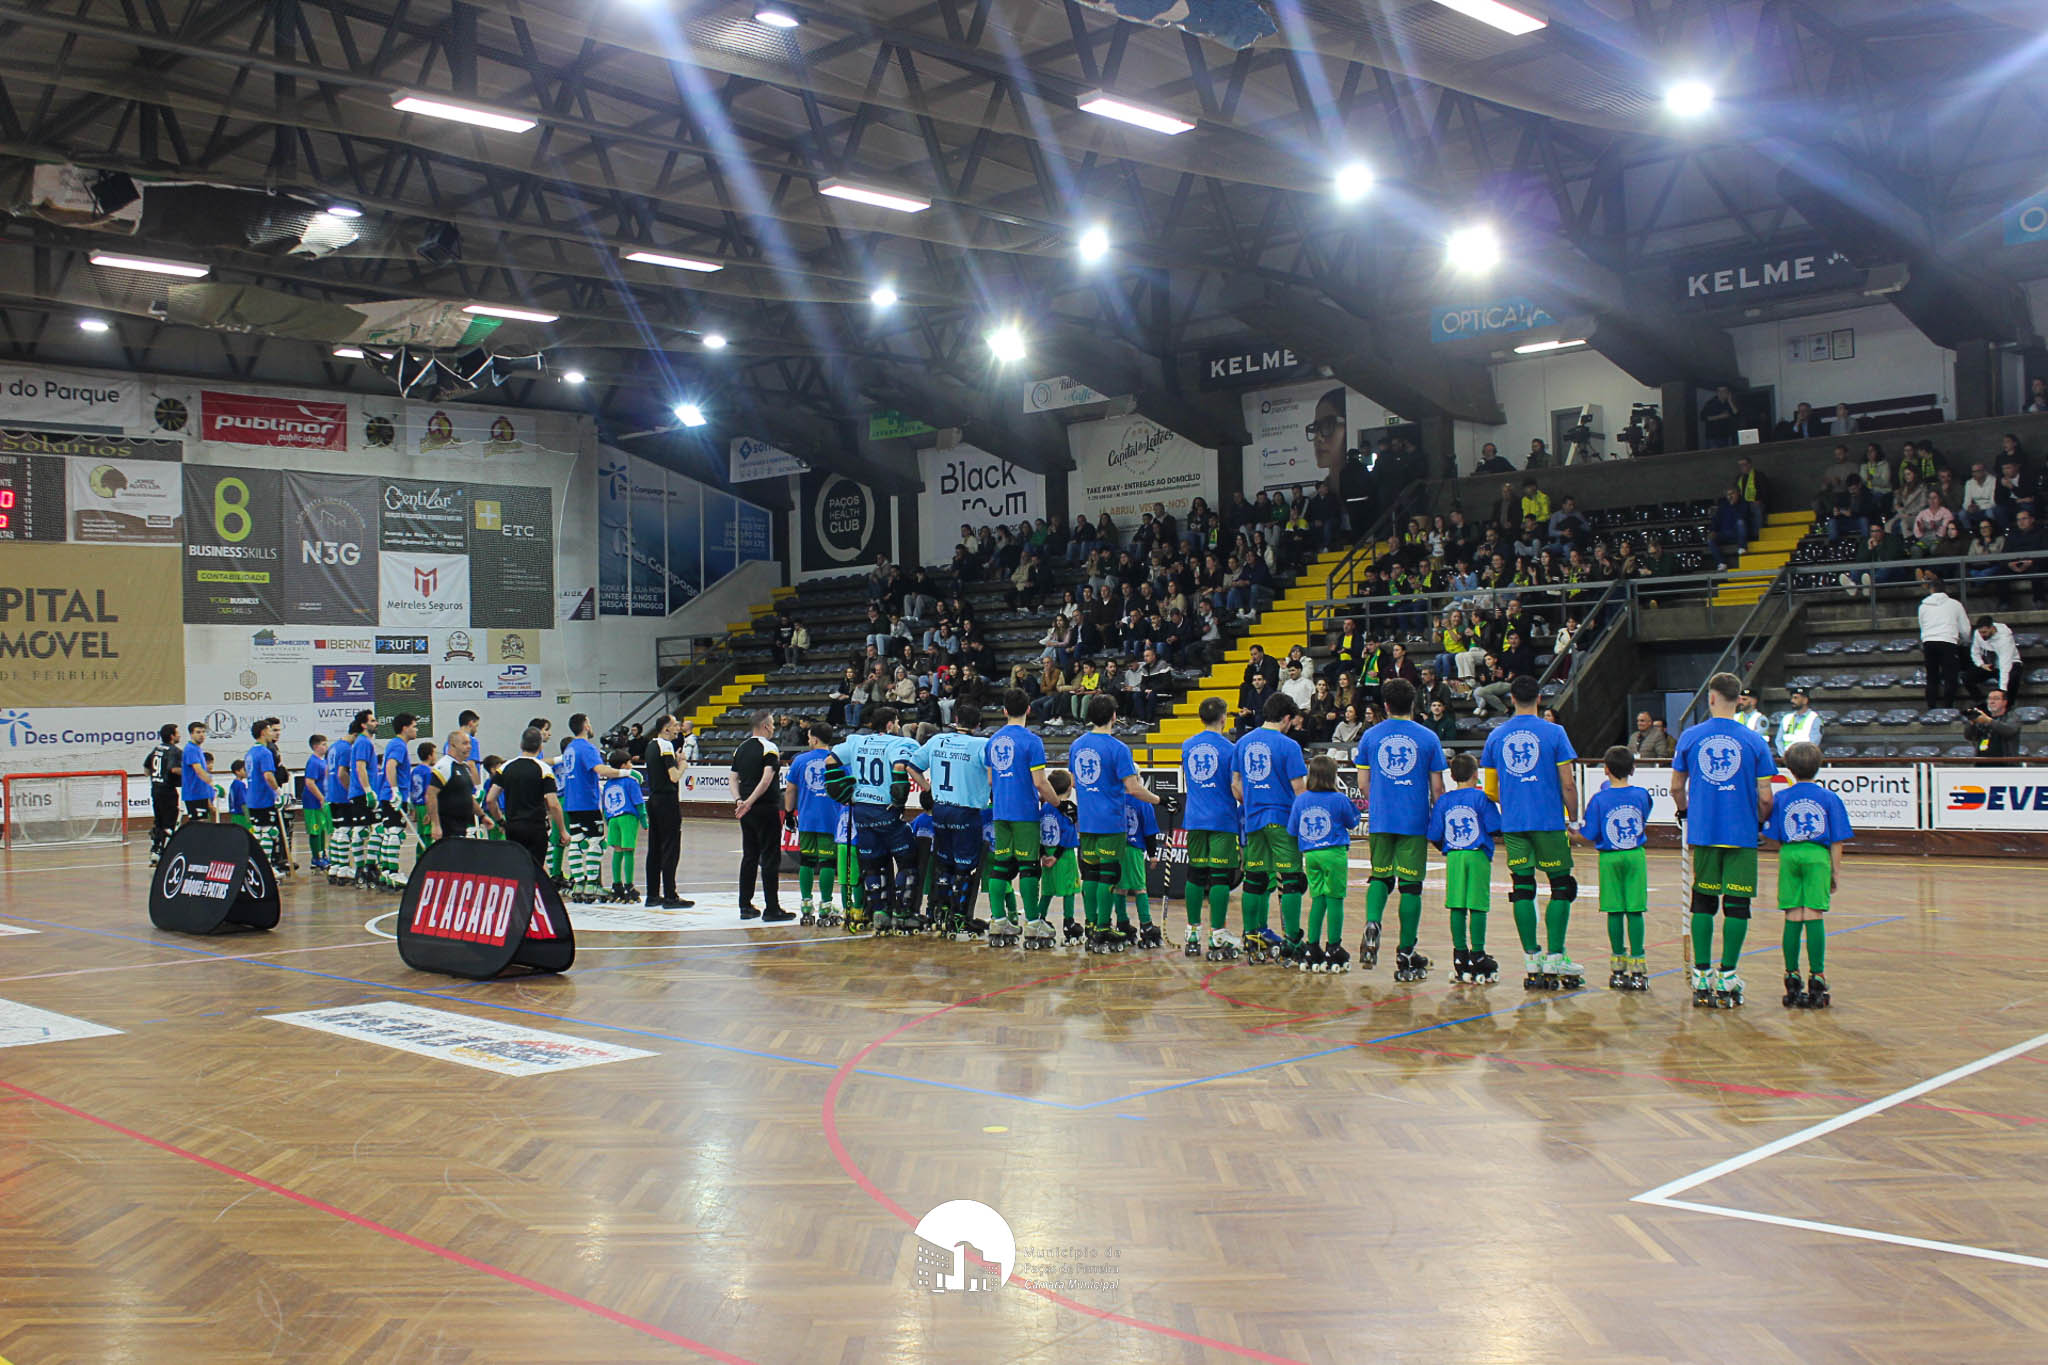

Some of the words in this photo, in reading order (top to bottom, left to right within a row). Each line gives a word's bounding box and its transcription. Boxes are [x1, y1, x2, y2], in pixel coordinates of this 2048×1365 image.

[1688, 256, 1816, 297] KELME
[1211, 350, 1298, 378] KELME
[9, 379, 38, 396] do
[44, 381, 120, 405] Parque
[1108, 441, 1138, 467] Capital
[941, 459, 1017, 495] Black
[1086, 487, 1101, 495] TAKE
[1125, 480, 1155, 490] ENTREGAS
[829, 496, 859, 507] PAÇOS
[829, 508, 860, 519] HEALTH
[502, 525, 534, 536] ETC
[829, 519, 860, 533] CLUB
[302, 540, 361, 565] N3G
[0, 587, 119, 622] PITAL
[387, 600, 427, 610] Meireles
[429, 600, 463, 611] Seguros
[501, 665, 528, 675] JR
[444, 680, 483, 689] DIVERCOL
[224, 692, 272, 701] DIBSOFA
[25, 731, 58, 744] Des
[857, 756, 884, 786] 10
[939, 761, 954, 791] 1
[415, 878, 516, 938] PLACARD
